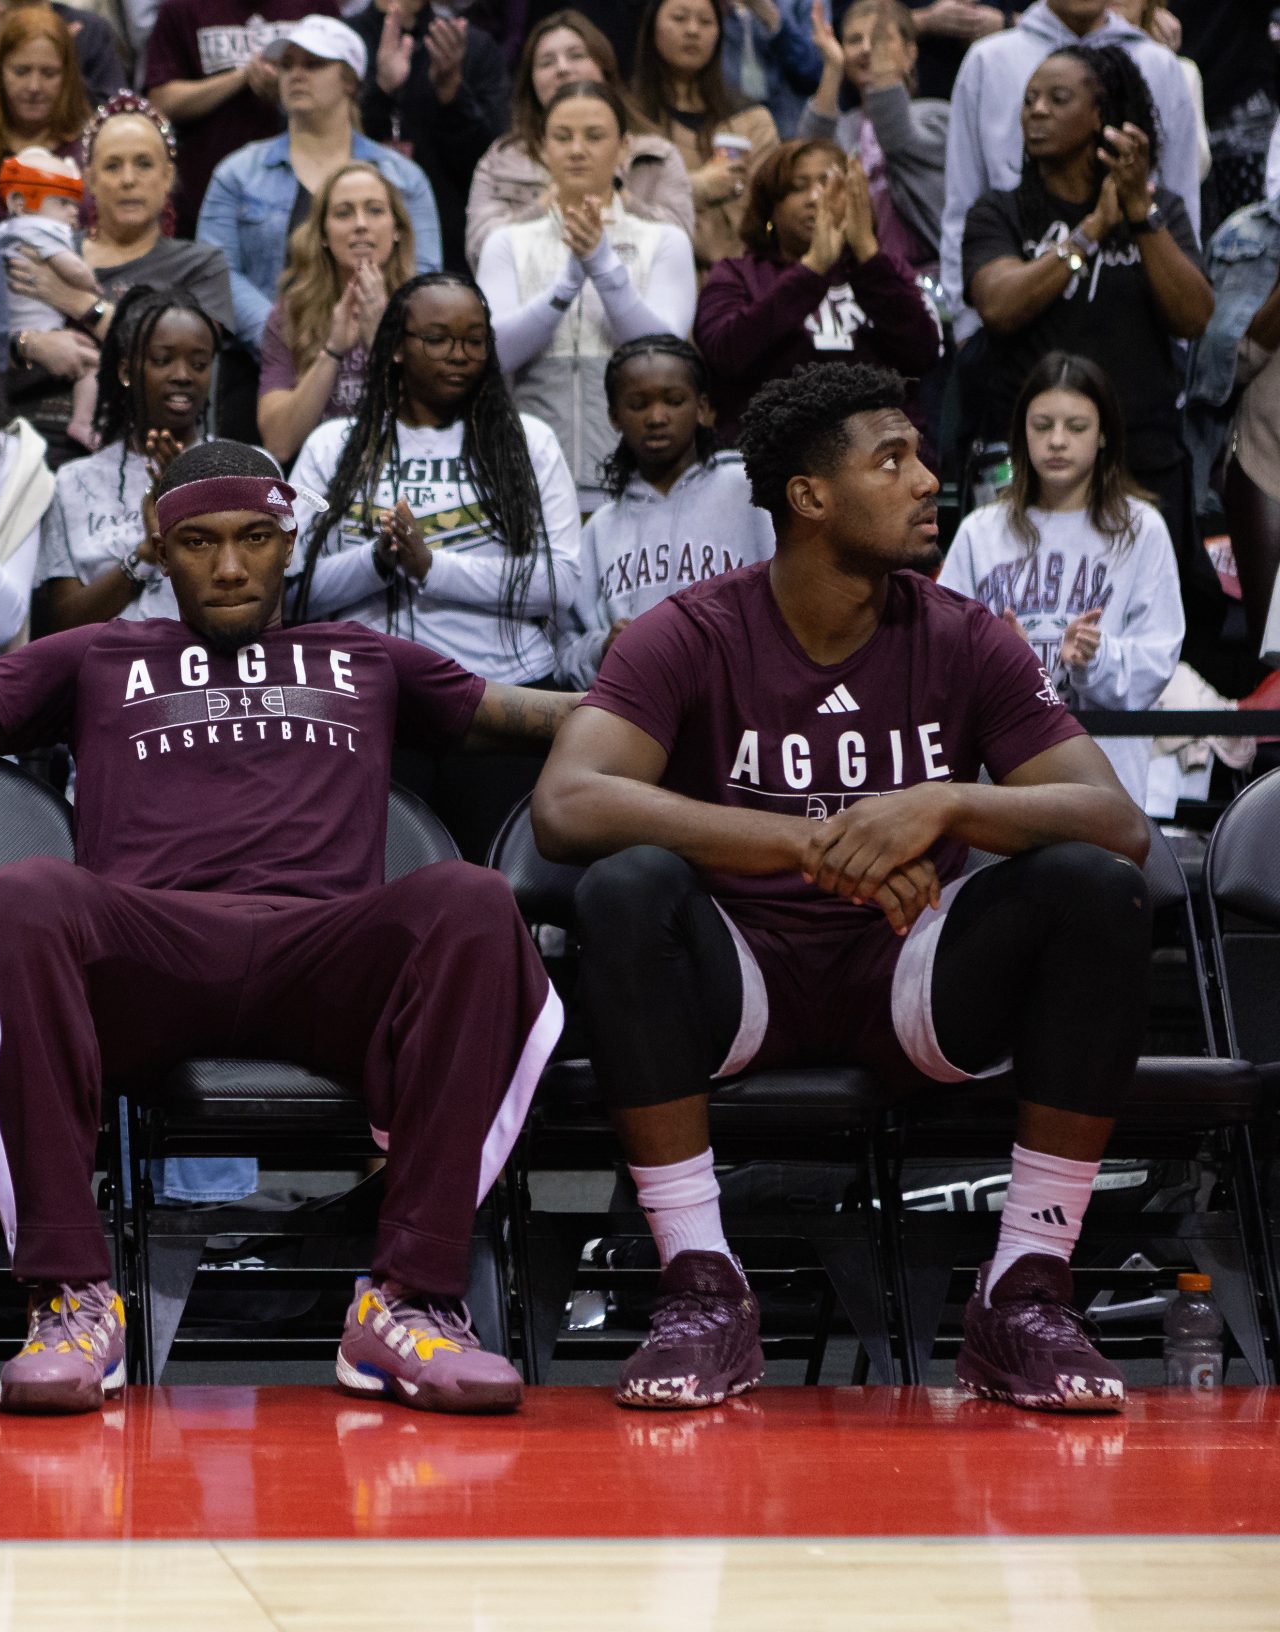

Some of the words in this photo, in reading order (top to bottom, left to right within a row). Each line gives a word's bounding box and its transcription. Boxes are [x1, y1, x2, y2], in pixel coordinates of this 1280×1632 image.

[599, 543, 670, 600] EXAS
[125, 643, 356, 696] AGGIE
[135, 721, 356, 760] BASKETBALL
[729, 722, 951, 790] AGGIE
